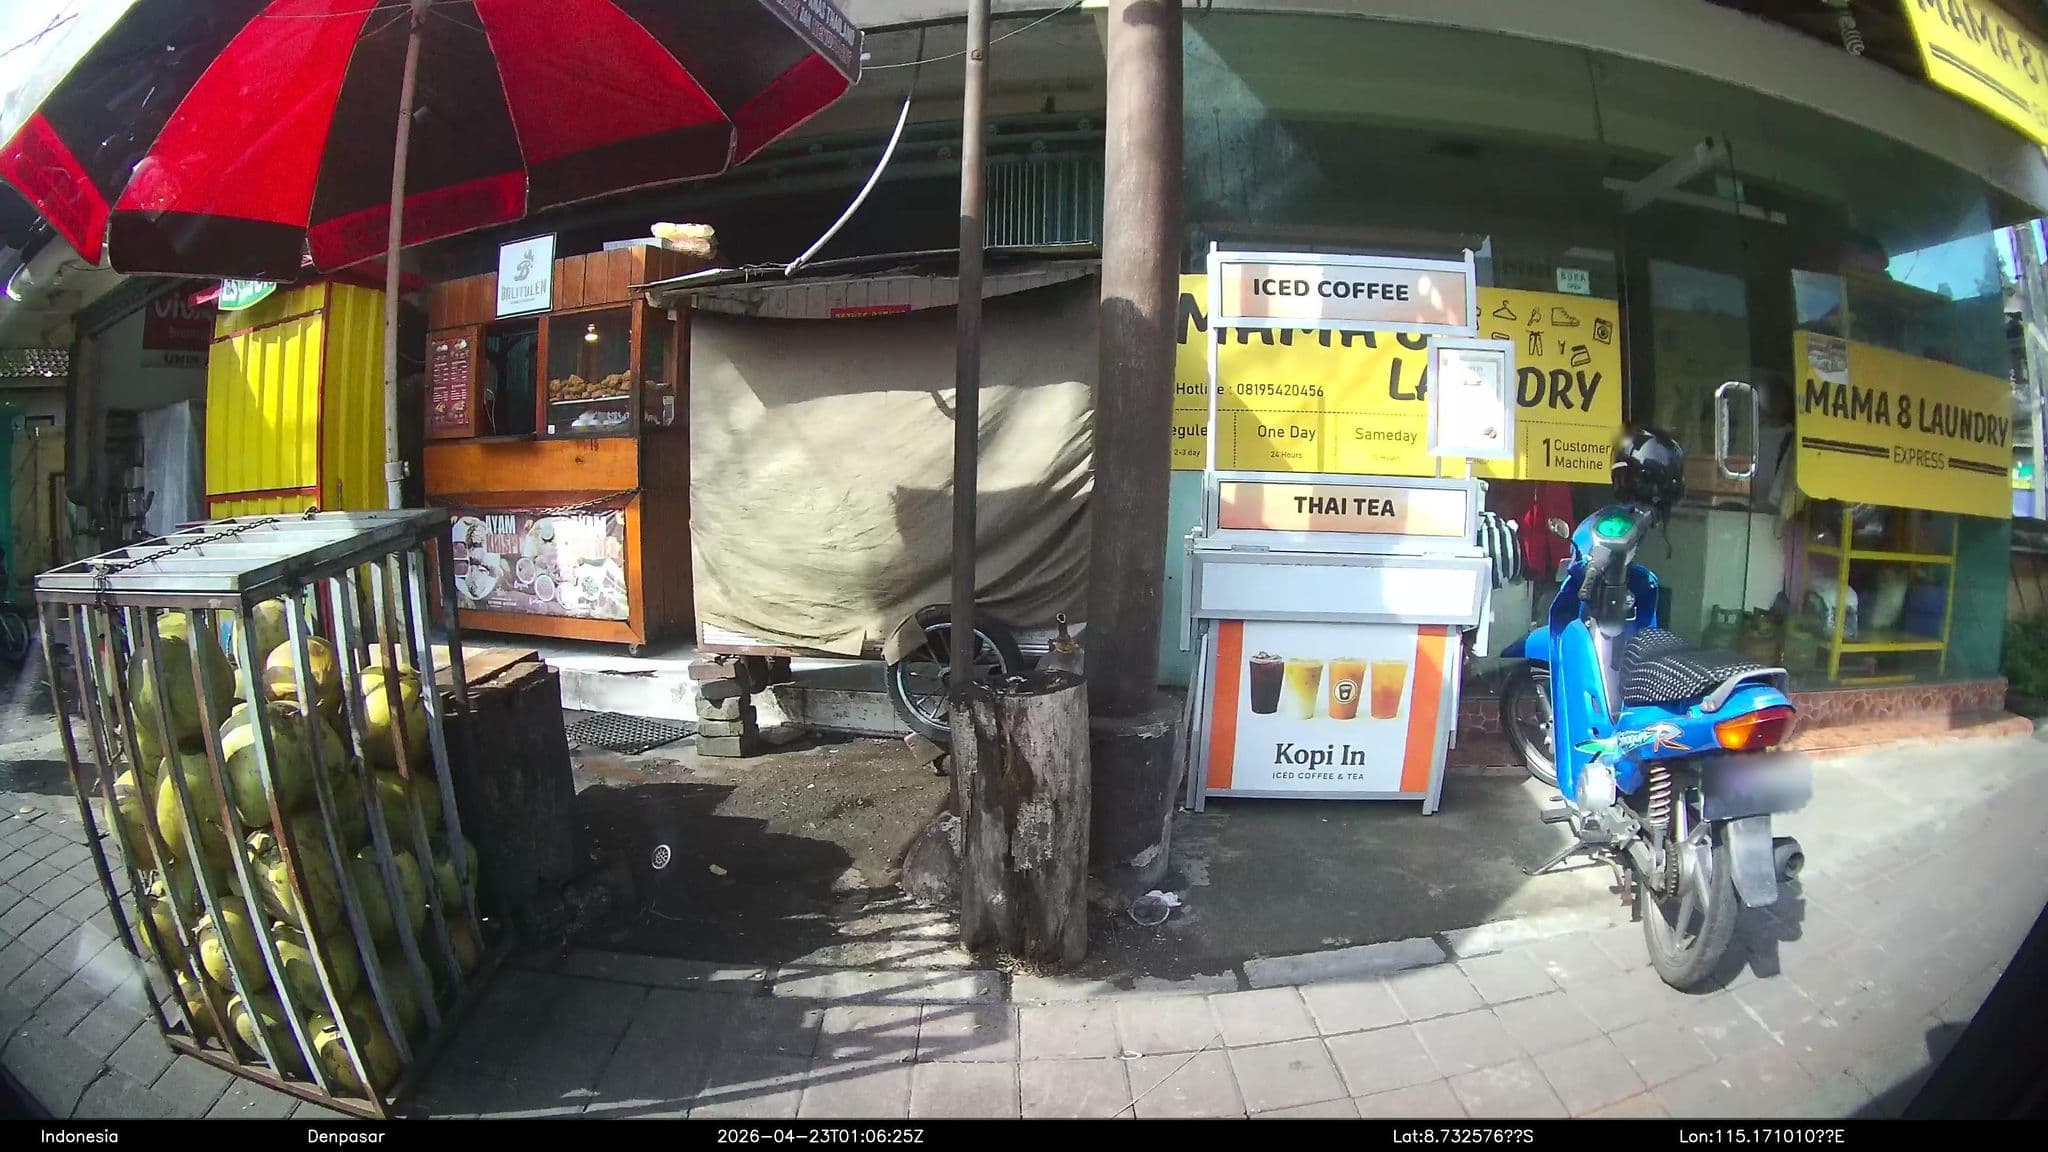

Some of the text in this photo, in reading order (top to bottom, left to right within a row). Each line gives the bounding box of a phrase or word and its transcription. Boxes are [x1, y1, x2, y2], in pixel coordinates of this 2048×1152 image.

[1253, 279, 1409, 302] ICED COFFEE
[1176, 382, 1225, 395] Hotlie
[1237, 383, 1324, 397] 08195420456
[1804, 378, 2009, 448] MAMA 8 LAUNDRY
[1257, 425, 1316, 442] One Day
[1355, 427, 1418, 445] Sameday
[1187, 448, 1201, 458] day
[1281, 451, 1303, 459] Hours
[1542, 438, 1610, 467] 1 Customer
[1893, 446, 1945, 470] EXPRESS
[1555, 456, 1603, 470] Machine
[1294, 496, 1395, 517] THAI TEA
[485, 514, 516, 534] AYAM
[1274, 743, 1366, 770] Kopi In
[1272, 772, 1294, 780] ICED
